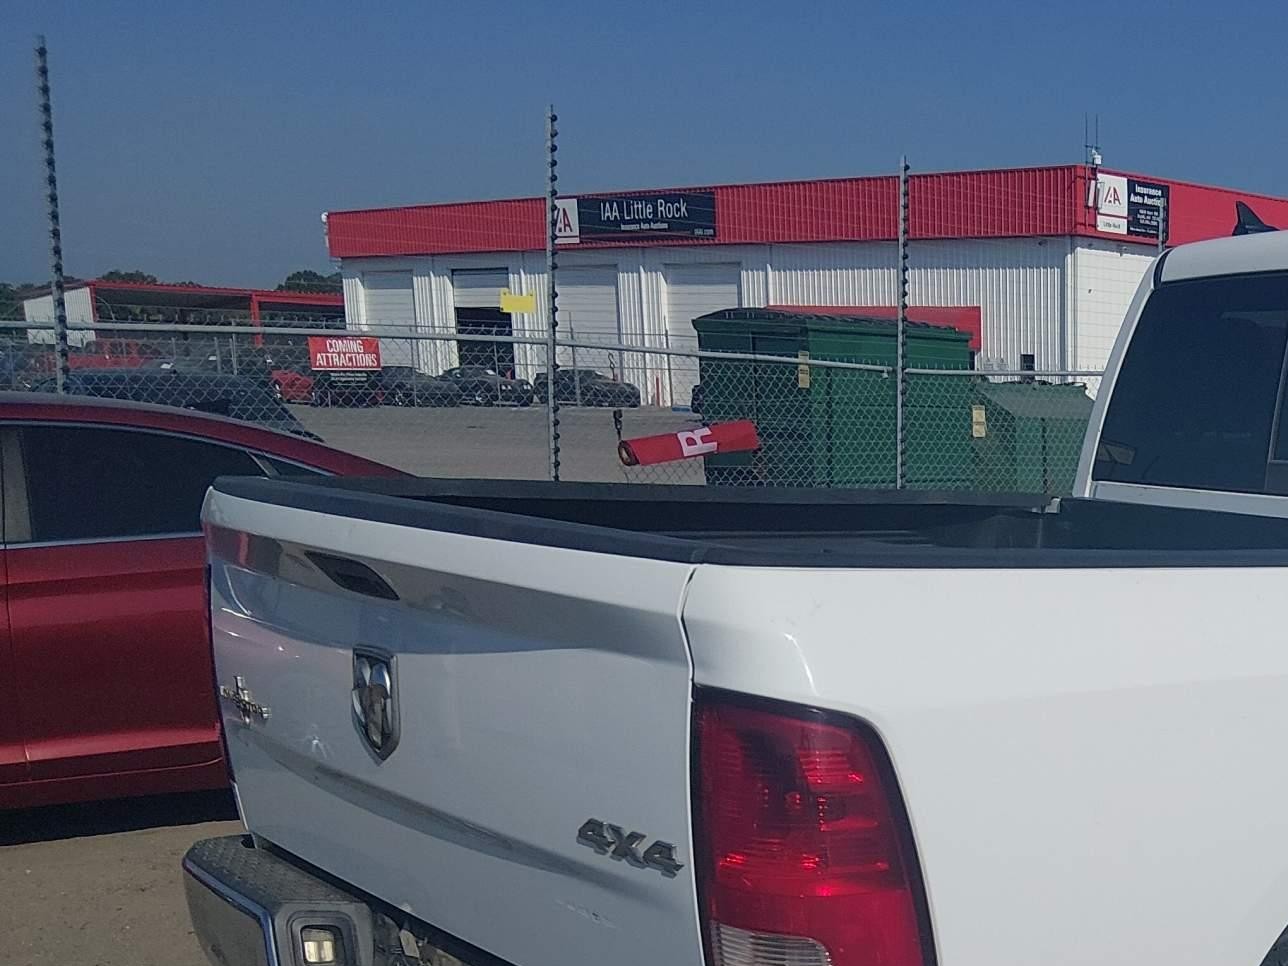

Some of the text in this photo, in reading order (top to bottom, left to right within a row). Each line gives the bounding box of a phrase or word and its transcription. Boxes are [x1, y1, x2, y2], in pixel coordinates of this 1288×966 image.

[1135, 184, 1162, 196] Insurance
[600, 198, 689, 221] IAA Little Rock
[326, 340, 364, 353] COMING
[316, 353, 378, 367] ATTRACTIONS
